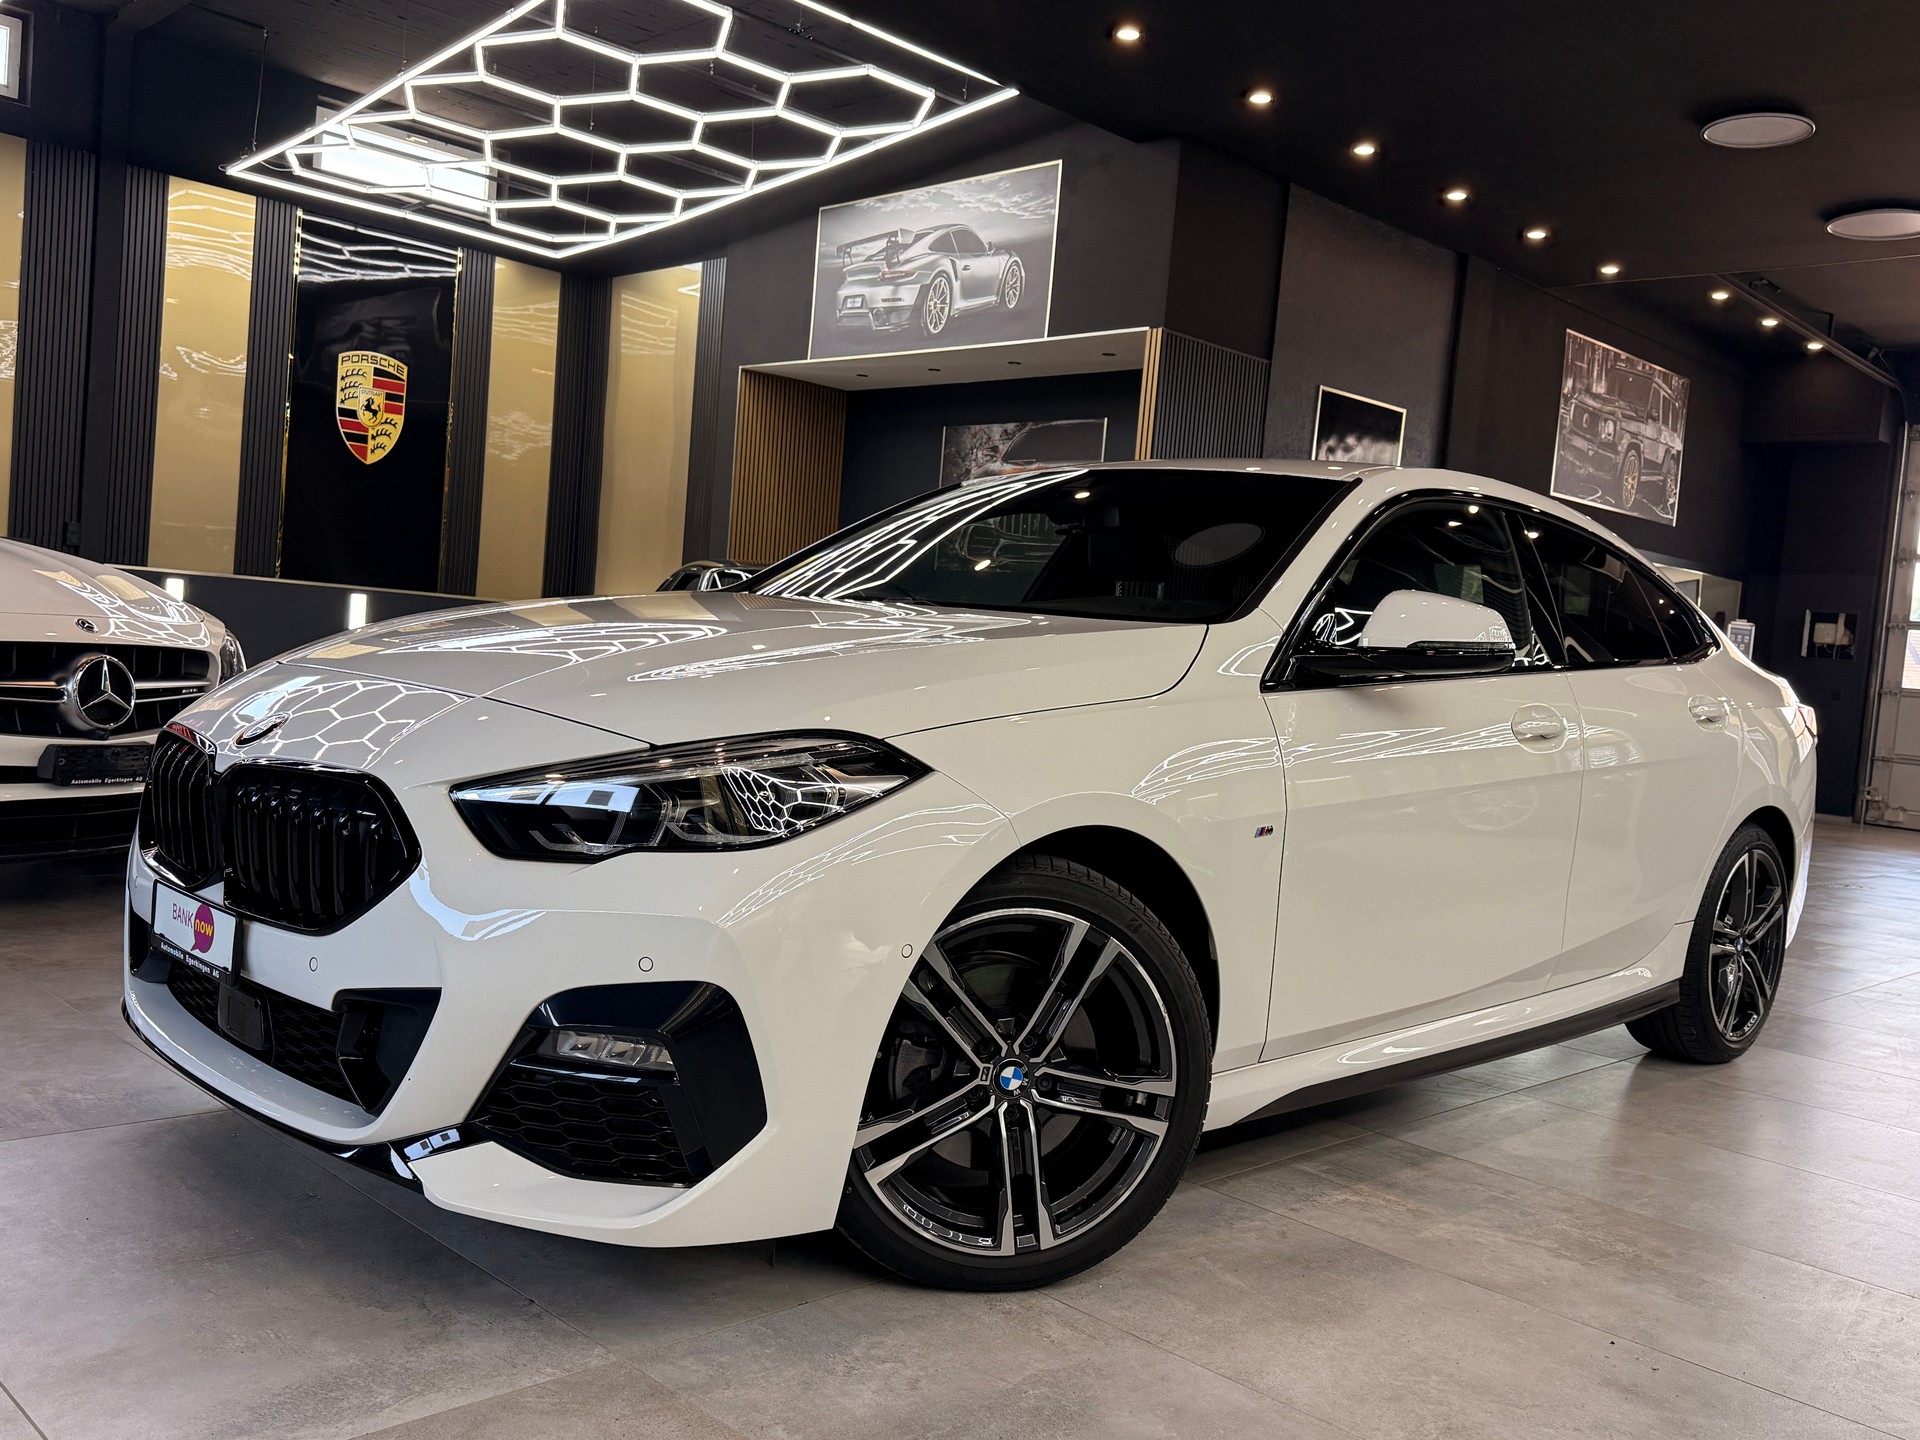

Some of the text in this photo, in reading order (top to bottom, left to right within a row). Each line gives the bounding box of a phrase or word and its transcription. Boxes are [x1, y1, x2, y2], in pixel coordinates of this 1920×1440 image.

[341, 354, 405, 377] PORSCHE
[172, 903, 214, 937] BANK now
[161, 942, 220, 979] Automobile Egerkingen AG
